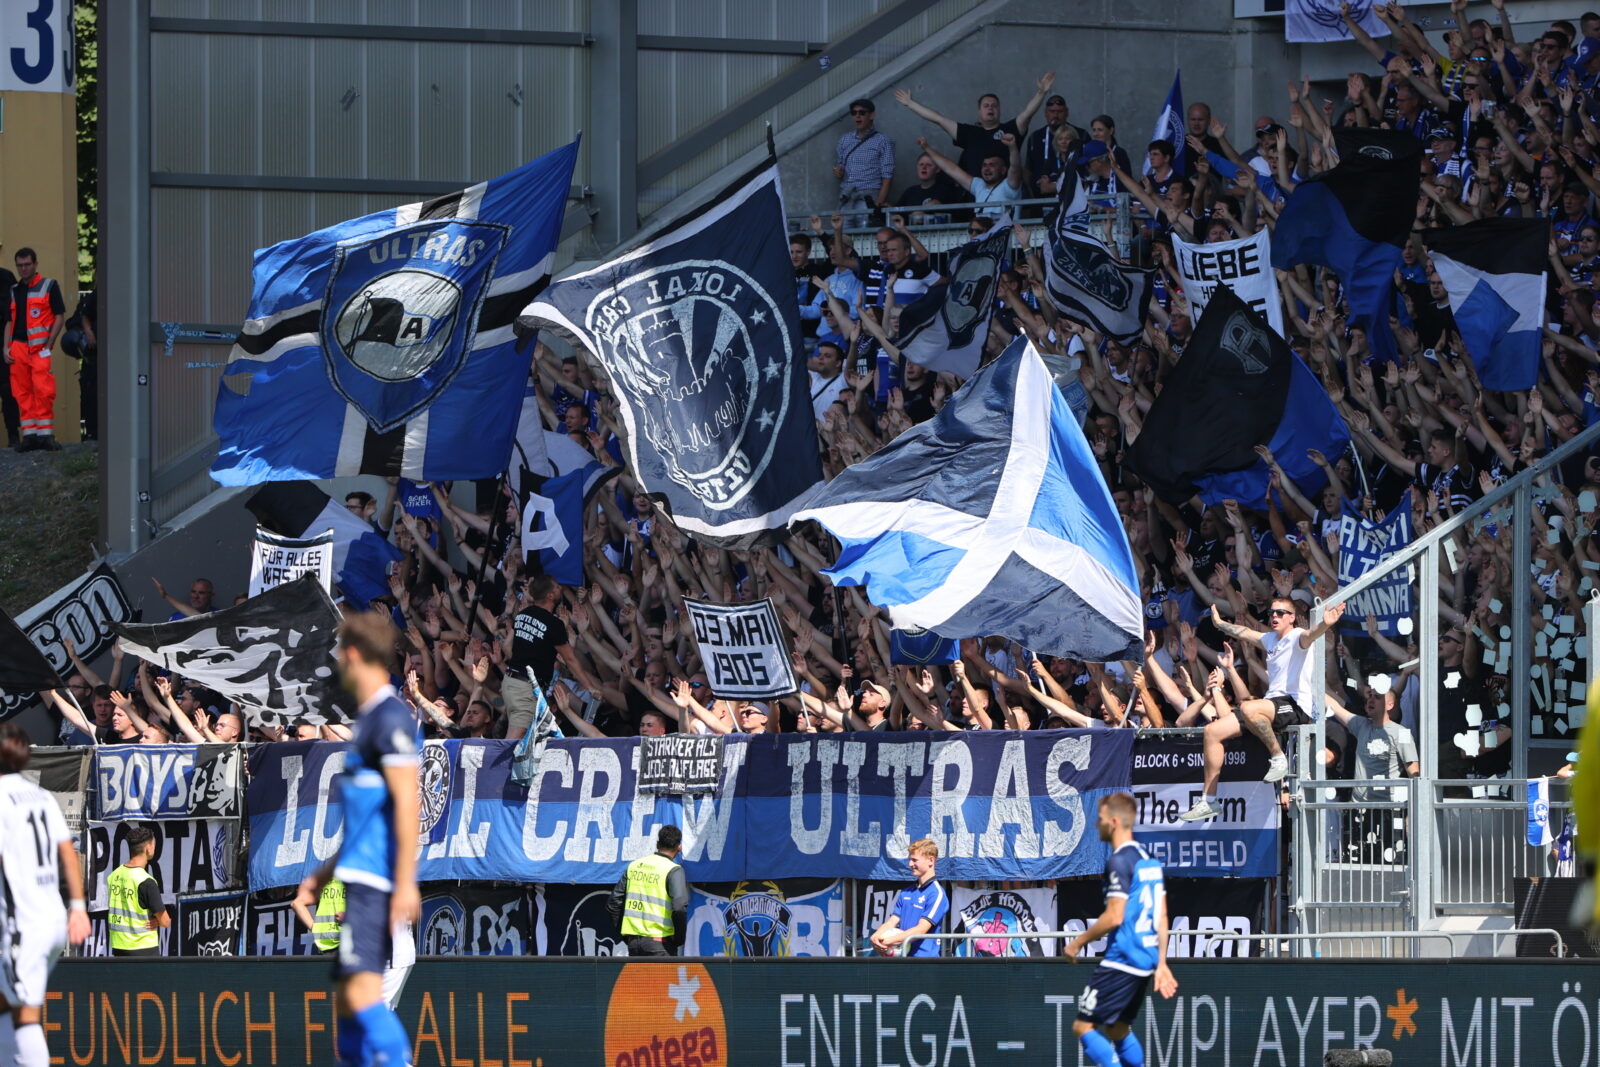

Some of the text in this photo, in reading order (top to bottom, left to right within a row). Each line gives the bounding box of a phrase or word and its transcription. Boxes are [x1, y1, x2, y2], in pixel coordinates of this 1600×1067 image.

[10, 0, 54, 84] 3
[369, 231, 485, 267] ULTRAS
[1180, 243, 1260, 281] LIEBE
[401, 318, 423, 339] A
[521, 491, 570, 565] A
[262, 547, 321, 567] FÜR ALLES
[692, 612, 773, 646] 03.MAI
[712, 652, 771, 686] 1905
[695, 738, 717, 757] ALS
[1134, 753, 1170, 769] BLOCK
[1172, 753, 1179, 768] 6
[100, 752, 194, 816] BOYS
[669, 758, 718, 779] AUFLAGE
[274, 745, 491, 867] LOL
[787, 734, 1092, 859] ULTRAS
[1134, 791, 1180, 825] The
[27, 809, 52, 867] 11
[1142, 840, 1247, 868] IELEFELD
[204, 905, 242, 931] LIPPE
[628, 900, 643, 911] 190
[43, 990, 276, 1066] EUNDLICH
[412, 991, 543, 1067] ALLE.
[780, 993, 976, 1067] ENTEGA
[1441, 997, 1534, 1067] MIT
